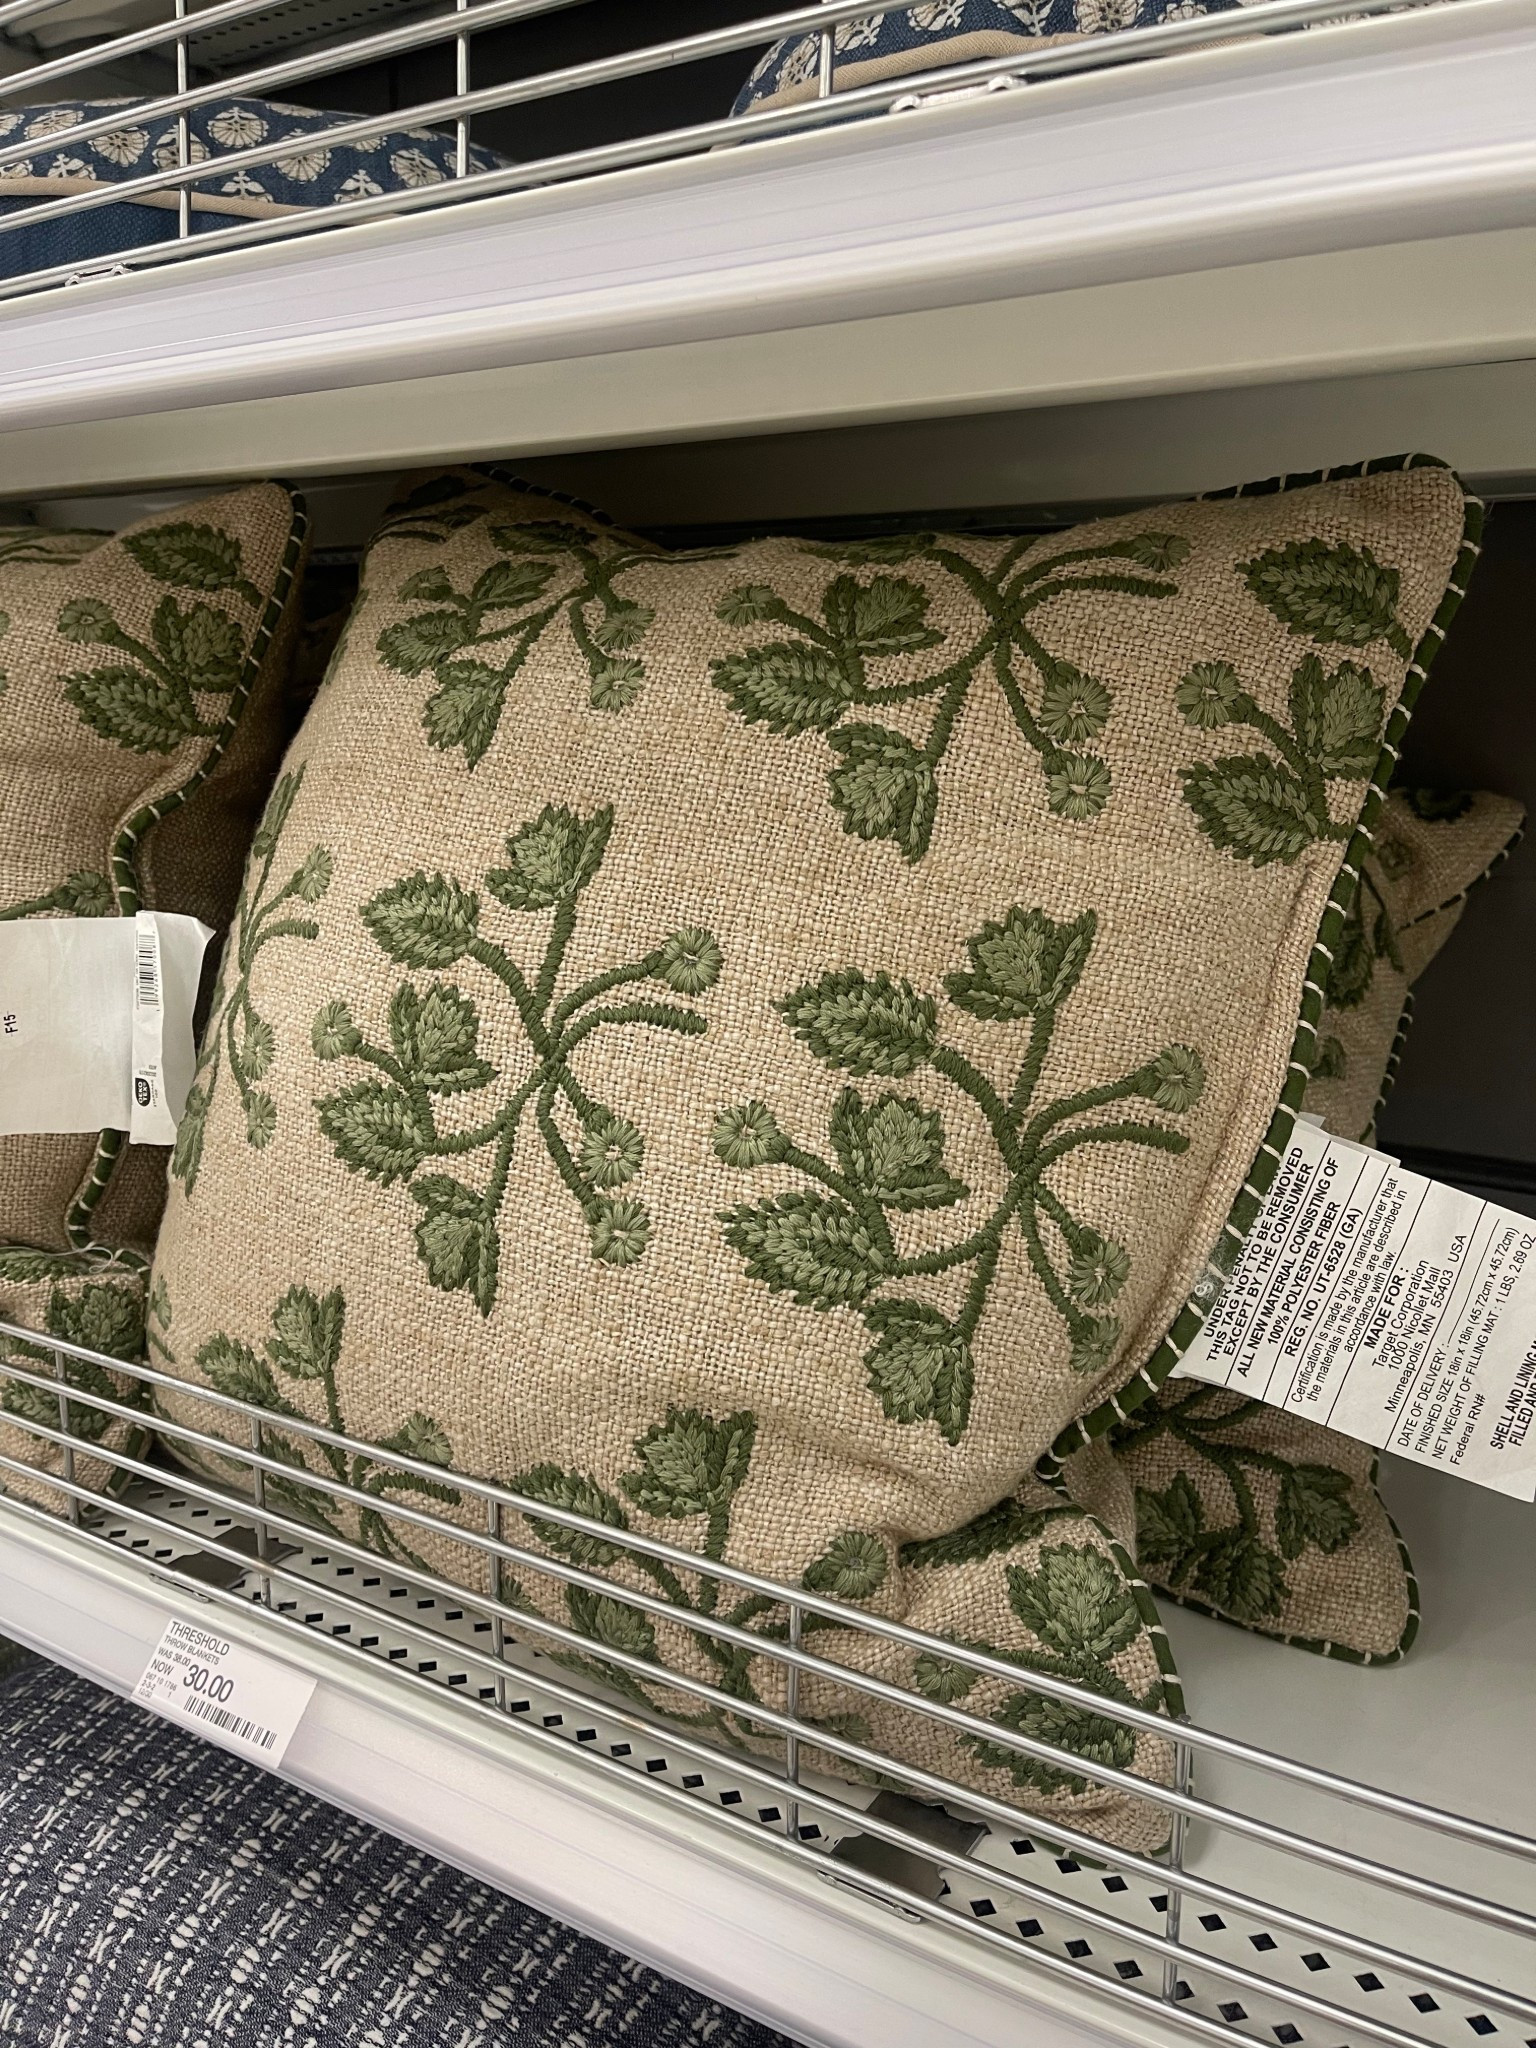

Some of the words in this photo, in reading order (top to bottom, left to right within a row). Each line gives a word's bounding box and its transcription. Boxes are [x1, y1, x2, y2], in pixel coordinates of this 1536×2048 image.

[3, 1014, 18, 1033] F15
[1380, 1177, 1398, 1198] that
[1393, 1189, 1407, 1201] in
[1352, 1198, 1387, 1268] manufacturer
[1372, 1200, 1402, 1252] described
[1519, 1232, 1536, 1250] OZ
[1205, 1330, 1227, 1361] THIS
[1220, 1298, 1240, 1326] TAG
[1233, 1264, 1253, 1296] NOT
[1245, 1242, 1262, 1261] TO
[1255, 1219, 1273, 1241] BE
[1265, 1146, 1303, 1218] REMOVED
[1222, 1298, 1253, 1356] EXCEPT
[1246, 1275, 1263, 1298] BY
[1255, 1245, 1277, 1273] THE
[1269, 1162, 1314, 1243] CONSUMER
[1365, 1253, 1380, 1272] are
[1377, 1250, 1396, 1270] law.
[1489, 1226, 1520, 1271] 45.72cm)
[1508, 1249, 1527, 1273] 2.69
[1236, 1352, 1255, 1377] ALL
[1246, 1317, 1268, 1349] NEW
[1260, 1257, 1297, 1318] MATERIAL
[1288, 1178, 1331, 1254] CONSISTING
[1323, 1156, 1338, 1177] OF
[1267, 1314, 1290, 1344] 100%
[1280, 1239, 1323, 1313] POLYESTER
[1314, 1201, 1341, 1240] FIBER
[1283, 1324, 1308, 1357] REG.
[1300, 1297, 1321, 1321] NO.
[1312, 1240, 1346, 1293] UT-6528
[1338, 1207, 1363, 1239] (GA)
[1341, 1268, 1358, 1286] the
[1370, 1271, 1386, 1293] with
[1487, 1271, 1497, 1280] x
[1334, 1285, 1352, 1301] by
[1349, 1272, 1371, 1304] article
[1497, 1274, 1519, 1297] LBS,
[1203, 1287, 1231, 1337] UNDER
[1322, 1301, 1343, 1330] made
[1339, 1304, 1357, 1323] this
[1363, 1306, 1392, 1349] MADE
[1383, 1274, 1406, 1306] FOR
[1371, 1330, 1399, 1367] Target
[1390, 1259, 1429, 1329] Corporation
[1387, 1340, 1408, 1370] 1000
[1400, 1294, 1430, 1339] Nicollet
[1420, 1265, 1441, 1293] Mall
[1467, 1280, 1493, 1325] (45.72cm
[1314, 1330, 1329, 1341] is
[1332, 1324, 1348, 1335] in
[1343, 1294, 1377, 1352] accordance
[1383, 1340, 1426, 1412] Minneapolis,
[1417, 1312, 1436, 1336] MN
[1429, 1268, 1454, 1308] 55403
[1447, 1234, 1467, 1262] USA
[1457, 1325, 1474, 1345] 18in
[1481, 1309, 1499, 1334] MAT
[1315, 1335, 1342, 1383] materials
[1446, 1355, 1463, 1375] 18in
[1456, 1347, 1466, 1355] x
[1464, 1334, 1489, 1375] FILLING
[1286, 1341, 1326, 1403] Certification
[1458, 1375, 1472, 1392] OF
[1306, 1383, 1322, 1401] the
[1396, 1417, 1418, 1447] DATE
[1409, 1400, 1423, 1417] OF
[1416, 1347, 1446, 1401] DELIVERY
[1435, 1377, 1454, 1402] SIZE
[1489, 1415, 1515, 1449] SHELL
[1504, 1388, 1524, 1414] AND
[1514, 1352, 1536, 1388] LINING
[1414, 1402, 1443, 1453] FINISHED
[1440, 1391, 1466, 1435] WEIGHT
[1449, 1421, 1475, 1465] Federal
[1467, 1392, 1485, 1420] RN#
[1508, 1406, 1536, 1446] FILLED
[1431, 1435, 1448, 1459] NET
[164, 1635, 188, 1651] THROW
[186, 1645, 220, 1665] BLANKETS
[170, 1621, 230, 1656] THRESHOLD
[158, 1647, 173, 1659] WAS
[173, 1653, 191, 1667] 38.00
[141, 1680, 156, 1691] 2-3-2
[151, 1659, 174, 1676] NOW
[183, 1664, 234, 1703] 30.00
